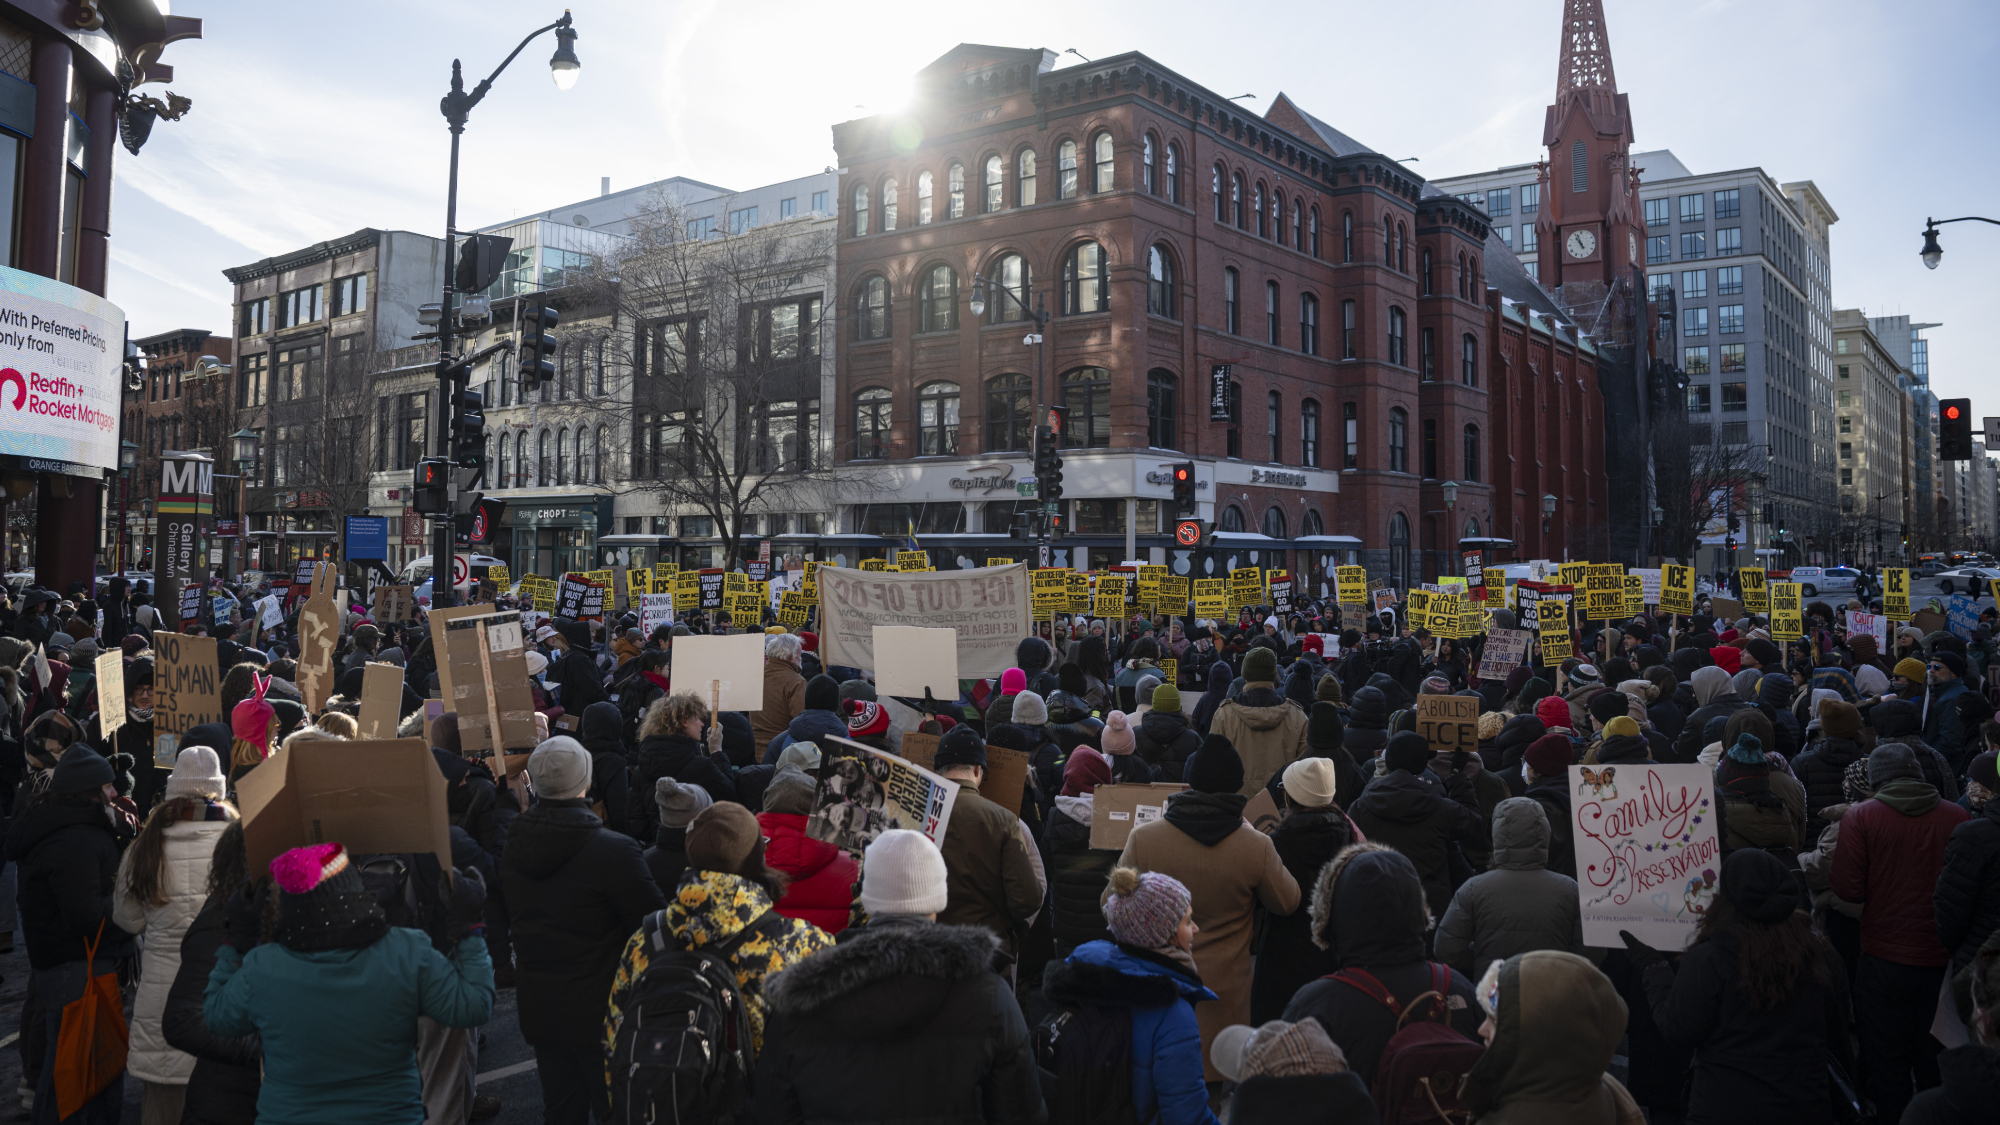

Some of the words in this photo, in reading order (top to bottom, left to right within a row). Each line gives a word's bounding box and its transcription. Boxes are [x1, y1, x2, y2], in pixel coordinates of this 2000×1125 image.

[0, 308, 28, 328] With
[31, 314, 81, 341] Preferred
[28, 335, 54, 354] from
[30, 372, 75, 398] Redfin
[30, 394, 76, 420] Rocket
[78, 403, 114, 433] Mortgage
[29, 459, 60, 472] ORANGE
[62, 462, 83, 475] BARREL
[162, 460, 196, 494] M
[199, 462, 213, 494] M
[538, 509, 566, 518] CHOPT
[167, 522, 179, 578] Chinatown
[177, 523, 194, 573] Gallery
[863, 562, 886, 571] JUSTICE
[898, 560, 926, 570] GENERAL
[1587, 566, 1610, 576] EXPAND
[1611, 566, 1622, 576] THE
[632, 570, 646, 587] ICE
[1035, 571, 1055, 579] JUSTICE
[1160, 577, 1187, 585] MINNESOTA
[1234, 571, 1257, 580] DC
[1562, 566, 1585, 584] STOP
[1668, 566, 1688, 589] ICE
[1742, 571, 1764, 588] STOP
[566, 581, 586, 592] TRUMP
[1045, 579, 1064, 587] VICTIMS
[1099, 579, 1124, 588] JUSTICE
[1233, 579, 1260, 587] MINNEAPOLIS
[1271, 582, 1291, 590] TRUMP
[1587, 576, 1623, 590] GENERAL
[1888, 570, 1903, 593] ICE
[565, 591, 582, 600] MUST
[1273, 590, 1290, 598] MUST
[1376, 589, 1391, 598] MELT
[1775, 585, 1784, 597] END
[1785, 585, 1796, 597] ALL
[643, 597, 671, 607] INHUMANE
[736, 595, 759, 605] JUSTICE
[1098, 598, 1121, 606] RENEE
[1410, 593, 1428, 610] STOP
[1432, 595, 1458, 603] JAIL
[1590, 592, 1621, 606] STRIKE!
[1661, 597, 1692, 609] COMMUNITIES
[1774, 598, 1797, 610] FUNDING
[1892, 596, 1896, 604] OF
[1897, 596, 1906, 605] OUR
[561, 607, 578, 617] NOW!
[782, 603, 807, 612] FOR
[1276, 605, 1292, 613] NOW!
[1430, 602, 1458, 615] KILLER
[1540, 605, 1563, 619] DC
[1884, 605, 1909, 614] COMMUNITIES
[1952, 597, 1964, 608] WE
[1966, 603, 1980, 615] ARE
[643, 609, 671, 620] CORRUPT
[735, 614, 757, 623] RENEE
[780, 611, 805, 623] RENEE
[1525, 610, 1536, 619] GO
[1855, 612, 1875, 625] QUIT
[1949, 610, 1979, 631] SANCTUARY
[1428, 616, 1458, 628] ICE
[1773, 618, 1800, 632] ICE/DHS!
[1849, 620, 1874, 634] VICTIM
[1950, 622, 1973, 641] COUNT
[1542, 634, 1569, 644] STOP
[155, 636, 180, 665] NO
[1483, 652, 1494, 660] WE
[1495, 652, 1513, 661] HAVE
[1515, 653, 1522, 662] TO
[1480, 661, 1492, 671] SAVE
[155, 662, 214, 696] HUMAN
[156, 691, 178, 712] IS
[1418, 700, 1476, 718] ABOLISH
[1420, 722, 1474, 746] ICE
[887, 763, 906, 801] BACK
[900, 770, 919, 814] THEM
[910, 774, 931, 823] BRING
[1578, 770, 1702, 887] Family
